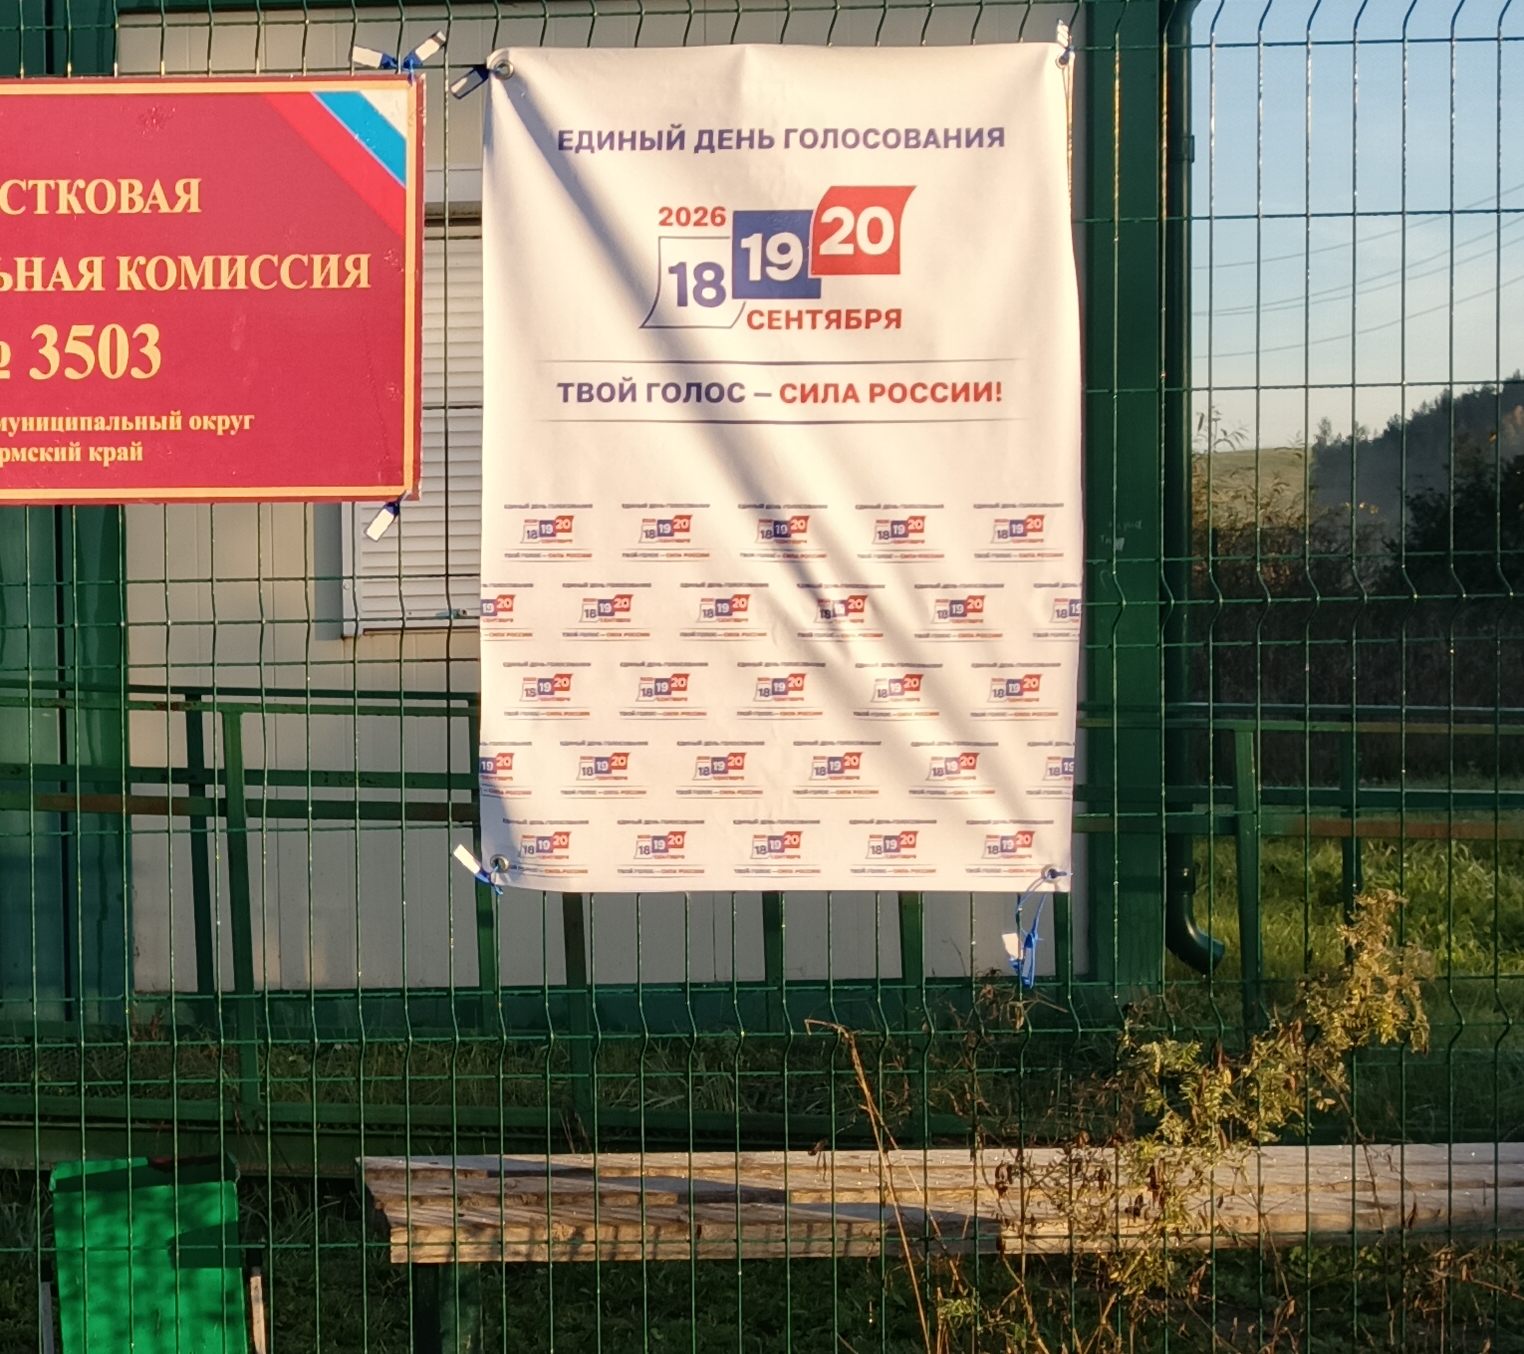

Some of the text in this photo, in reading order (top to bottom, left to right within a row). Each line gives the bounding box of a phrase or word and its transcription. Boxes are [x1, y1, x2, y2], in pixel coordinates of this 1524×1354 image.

[557, 124, 1006, 154] ЕДИНЫЙ ДЕНЬ ГОЛОСОВАНИЯ
[658, 205, 727, 228] 2026
[668, 205, 895, 309] 18 19 20
[116, 253, 371, 291] КОМИССИЯ
[746, 308, 903, 331] СЕНТЯБРЯ
[29, 323, 162, 380] 3503
[556, 376, 637, 405] ТВОЙ
[646, 381, 746, 405] ГОЛОС
[779, 382, 861, 405] СИЛА
[868, 380, 1002, 405] РОССИИ!
[188, 414, 256, 436] округ
[89, 441, 143, 466] край
[555, 519, 570, 530] 20
[673, 518, 688, 529] 20
[790, 518, 805, 529] 20
[907, 519, 922, 530] 20
[1025, 518, 1040, 529] 20
[496, 598, 511, 609] 20
[614, 597, 629, 608] 20
[732, 597, 747, 608] 20
[848, 598, 863, 609] 20
[966, 598, 981, 609] 20
[554, 677, 569, 688] 20
[671, 677, 686, 688] 20
[787, 677, 802, 688] 20
[904, 677, 919, 688] 20
[1022, 677, 1037, 688] 20
[497, 756, 512, 767] 20
[610, 756, 625, 767] 20
[727, 756, 742, 767] 20
[843, 756, 858, 767] 20
[960, 756, 975, 767] 20
[551, 835, 566, 846] 20
[667, 834, 682, 845] 20
[783, 834, 798, 845] 20
[899, 834, 914, 845] 20
[1016, 834, 1031, 845] 20
